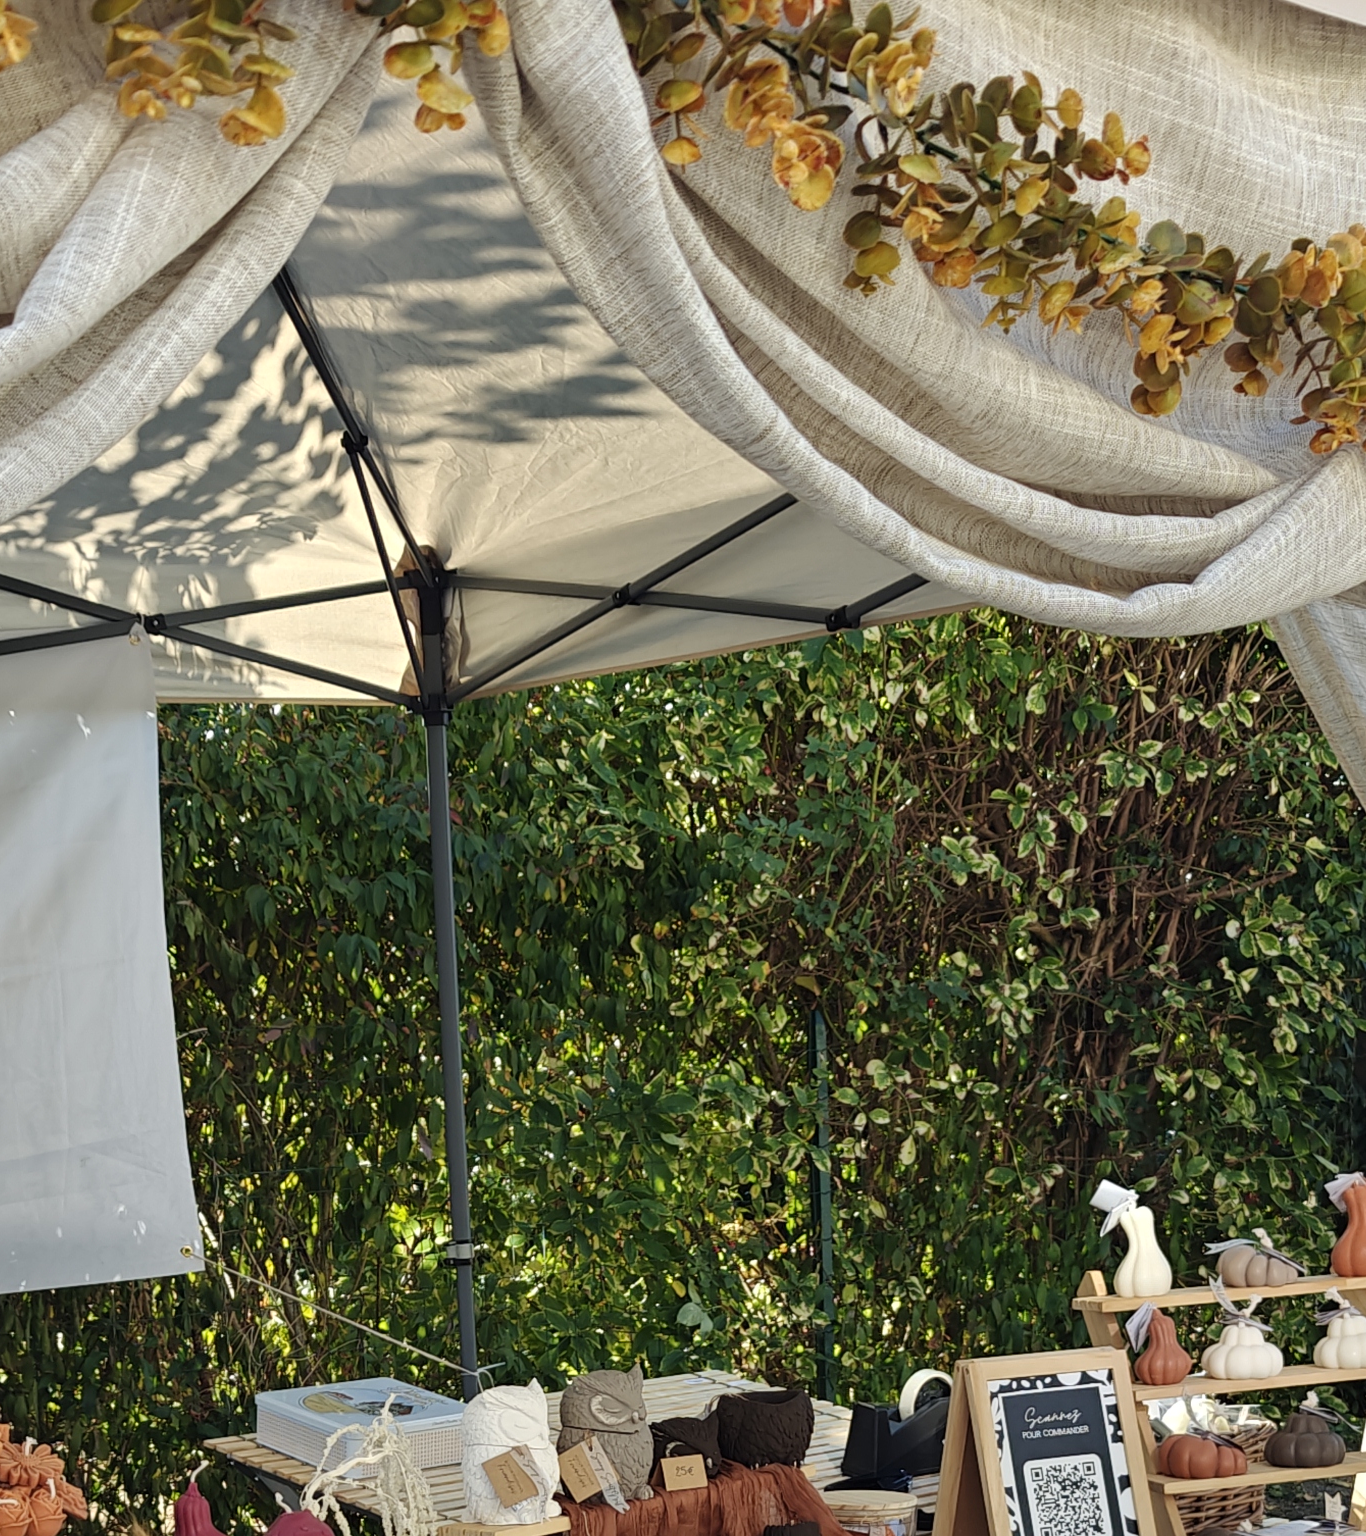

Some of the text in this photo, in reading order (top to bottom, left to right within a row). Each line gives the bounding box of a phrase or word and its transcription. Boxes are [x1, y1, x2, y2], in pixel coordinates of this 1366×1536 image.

[1024, 1406, 1082, 1429] Scannez
[1022, 1425, 1090, 1439] POUR COMMANDER
